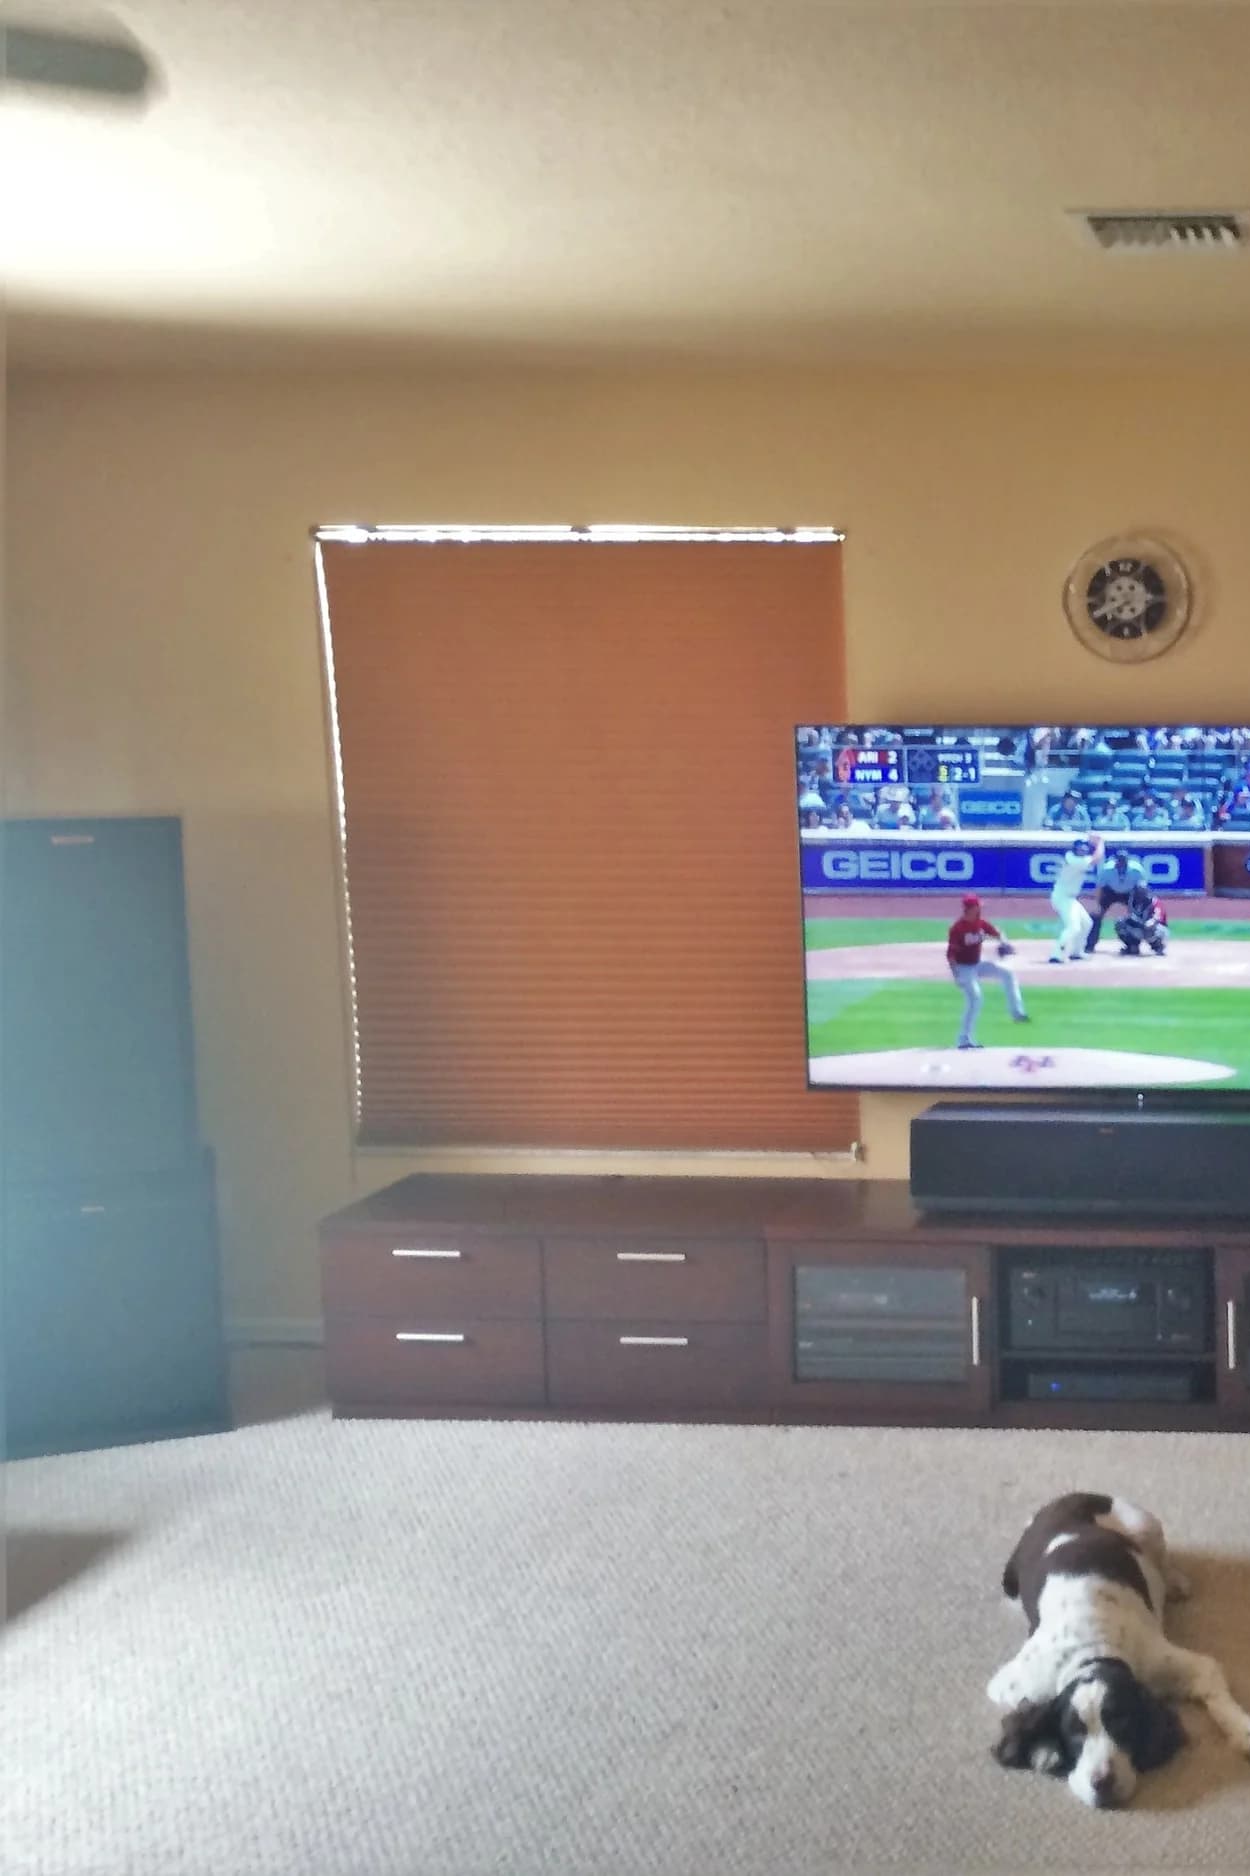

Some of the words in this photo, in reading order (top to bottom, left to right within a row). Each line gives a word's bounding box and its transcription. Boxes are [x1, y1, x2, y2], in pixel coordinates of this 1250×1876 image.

[887, 751, 898, 764] 2
[888, 768, 899, 782] 4
[822, 850, 975, 881] GEICO
